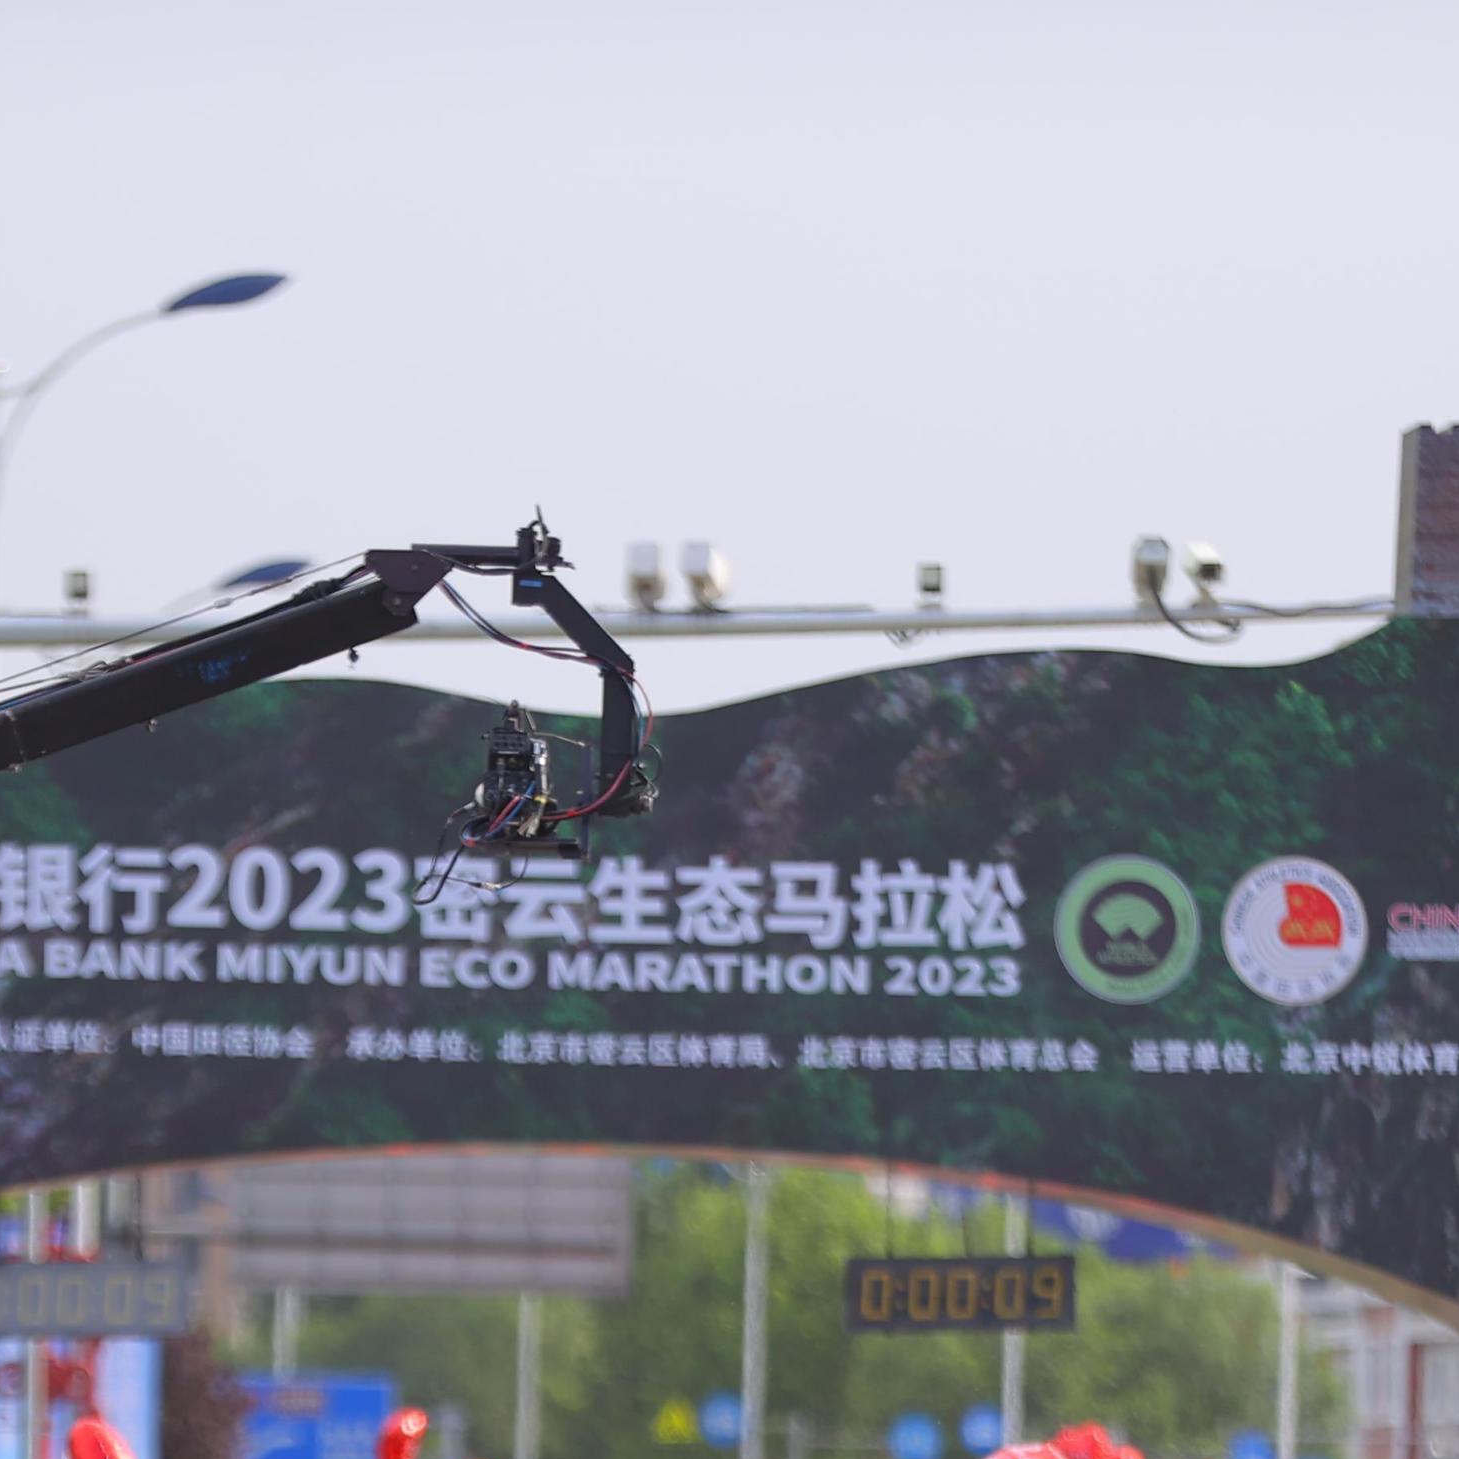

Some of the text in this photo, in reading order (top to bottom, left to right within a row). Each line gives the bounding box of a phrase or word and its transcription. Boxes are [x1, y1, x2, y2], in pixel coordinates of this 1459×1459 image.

[43, 940, 203, 982] BANK
[217, 943, 405, 986] MIYUN
[420, 947, 534, 990] ECO
[548, 951, 869, 995] MARATHON
[884, 957, 1021, 997] 2023
[860, 1267, 1065, 1322] 0:00:09
